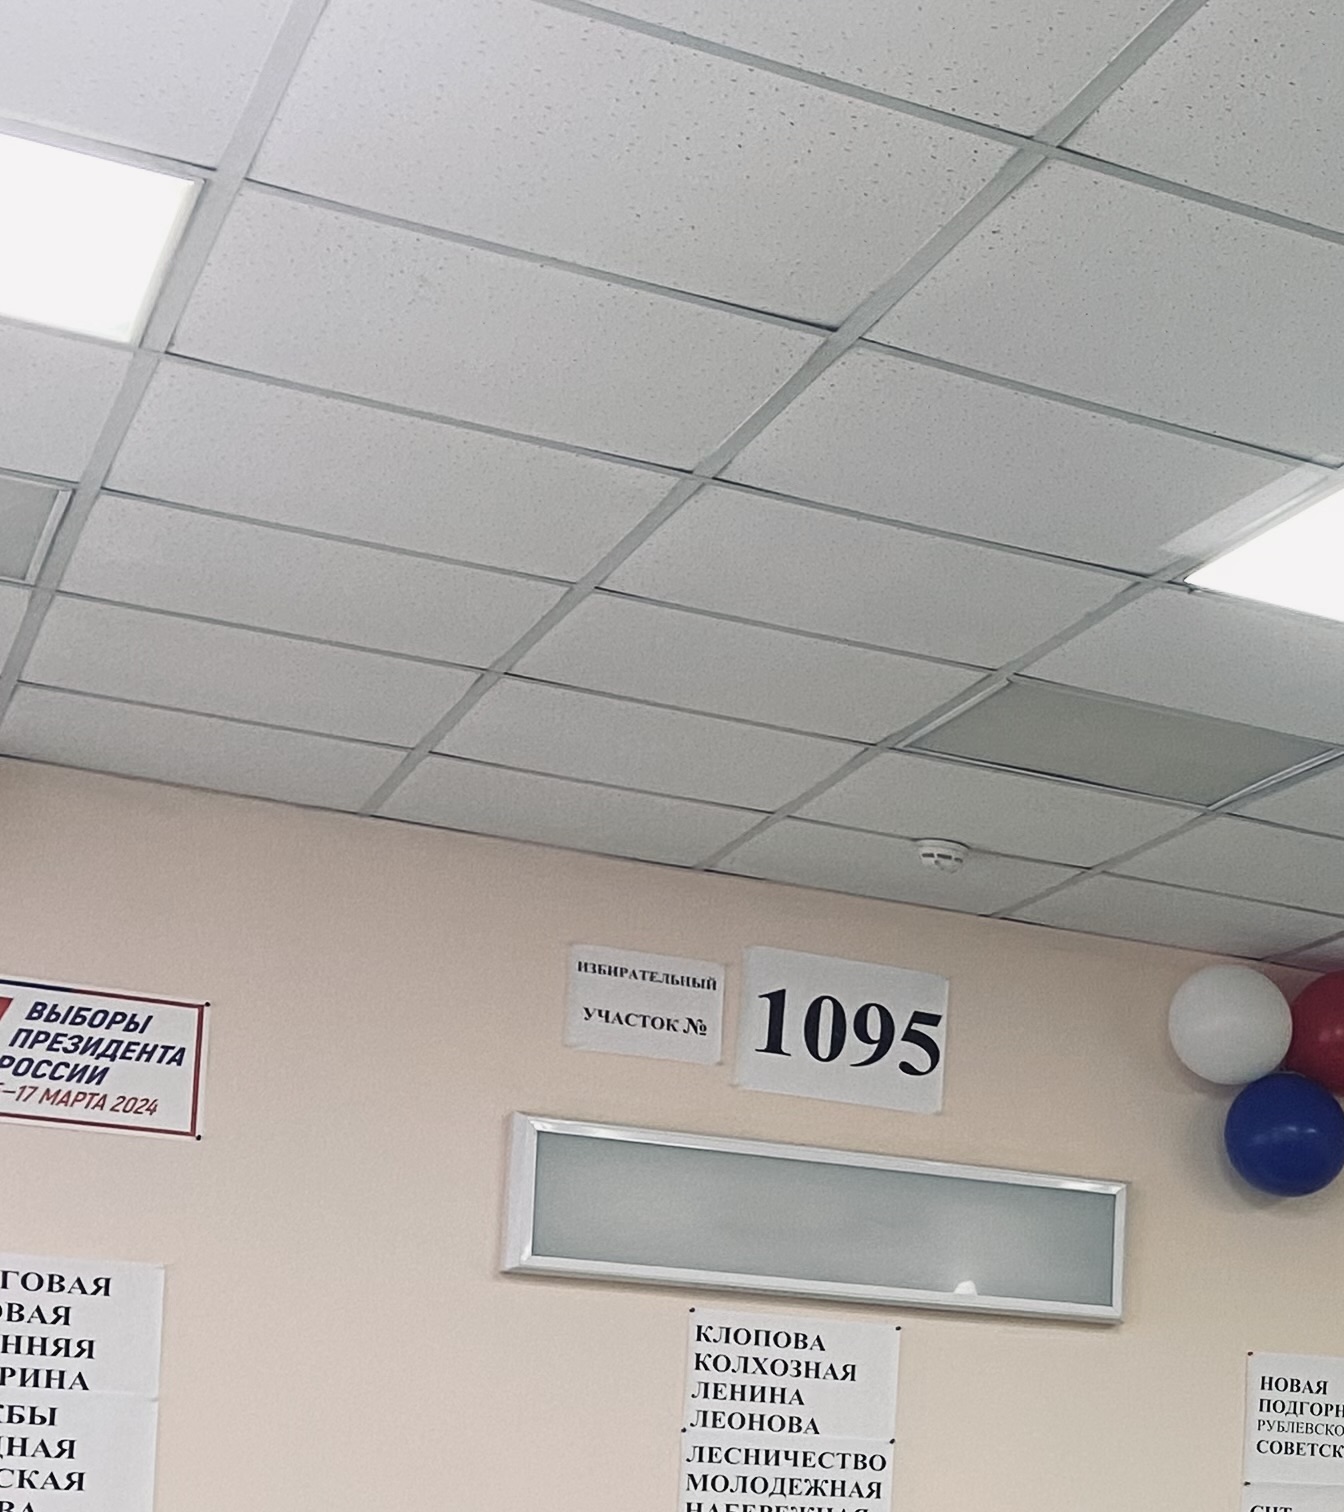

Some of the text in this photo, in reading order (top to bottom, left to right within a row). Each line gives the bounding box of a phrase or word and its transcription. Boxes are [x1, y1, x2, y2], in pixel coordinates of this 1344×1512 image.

[578, 960, 717, 991] ИЗБИРАТЕЛЬНЫЙ
[25, 1001, 153, 1034] ВЫБОРЫ
[583, 1006, 707, 1036] УЧАСТОК №
[755, 988, 942, 1076] 1095
[9, 1028, 186, 1066] ПРЕЗИДЕНТА
[39, 1088, 108, 1111] МАРТА
[110, 1096, 158, 1115] 2024
[0, 1302, 72, 1326] ВАЯ
[0, 1334, 96, 1359] ННЯЯ
[695, 1325, 826, 1351] КЛОПОВА
[695, 1353, 857, 1381] КОЛХОЗНАЯ
[691, 1381, 805, 1406] ЛЕНИНА
[1260, 1376, 1328, 1395] НОВАЯ
[0, 1404, 58, 1427] БЫ
[690, 1410, 820, 1435] ЛЕОНОВА
[0, 1436, 77, 1459] НАЯ
[686, 1446, 887, 1472] ЛЕСНИЧЕСТВО
[0, 1468, 86, 1491] СКАЯ
[686, 1473, 882, 1500] МОЛОДЕЖНАЯ
